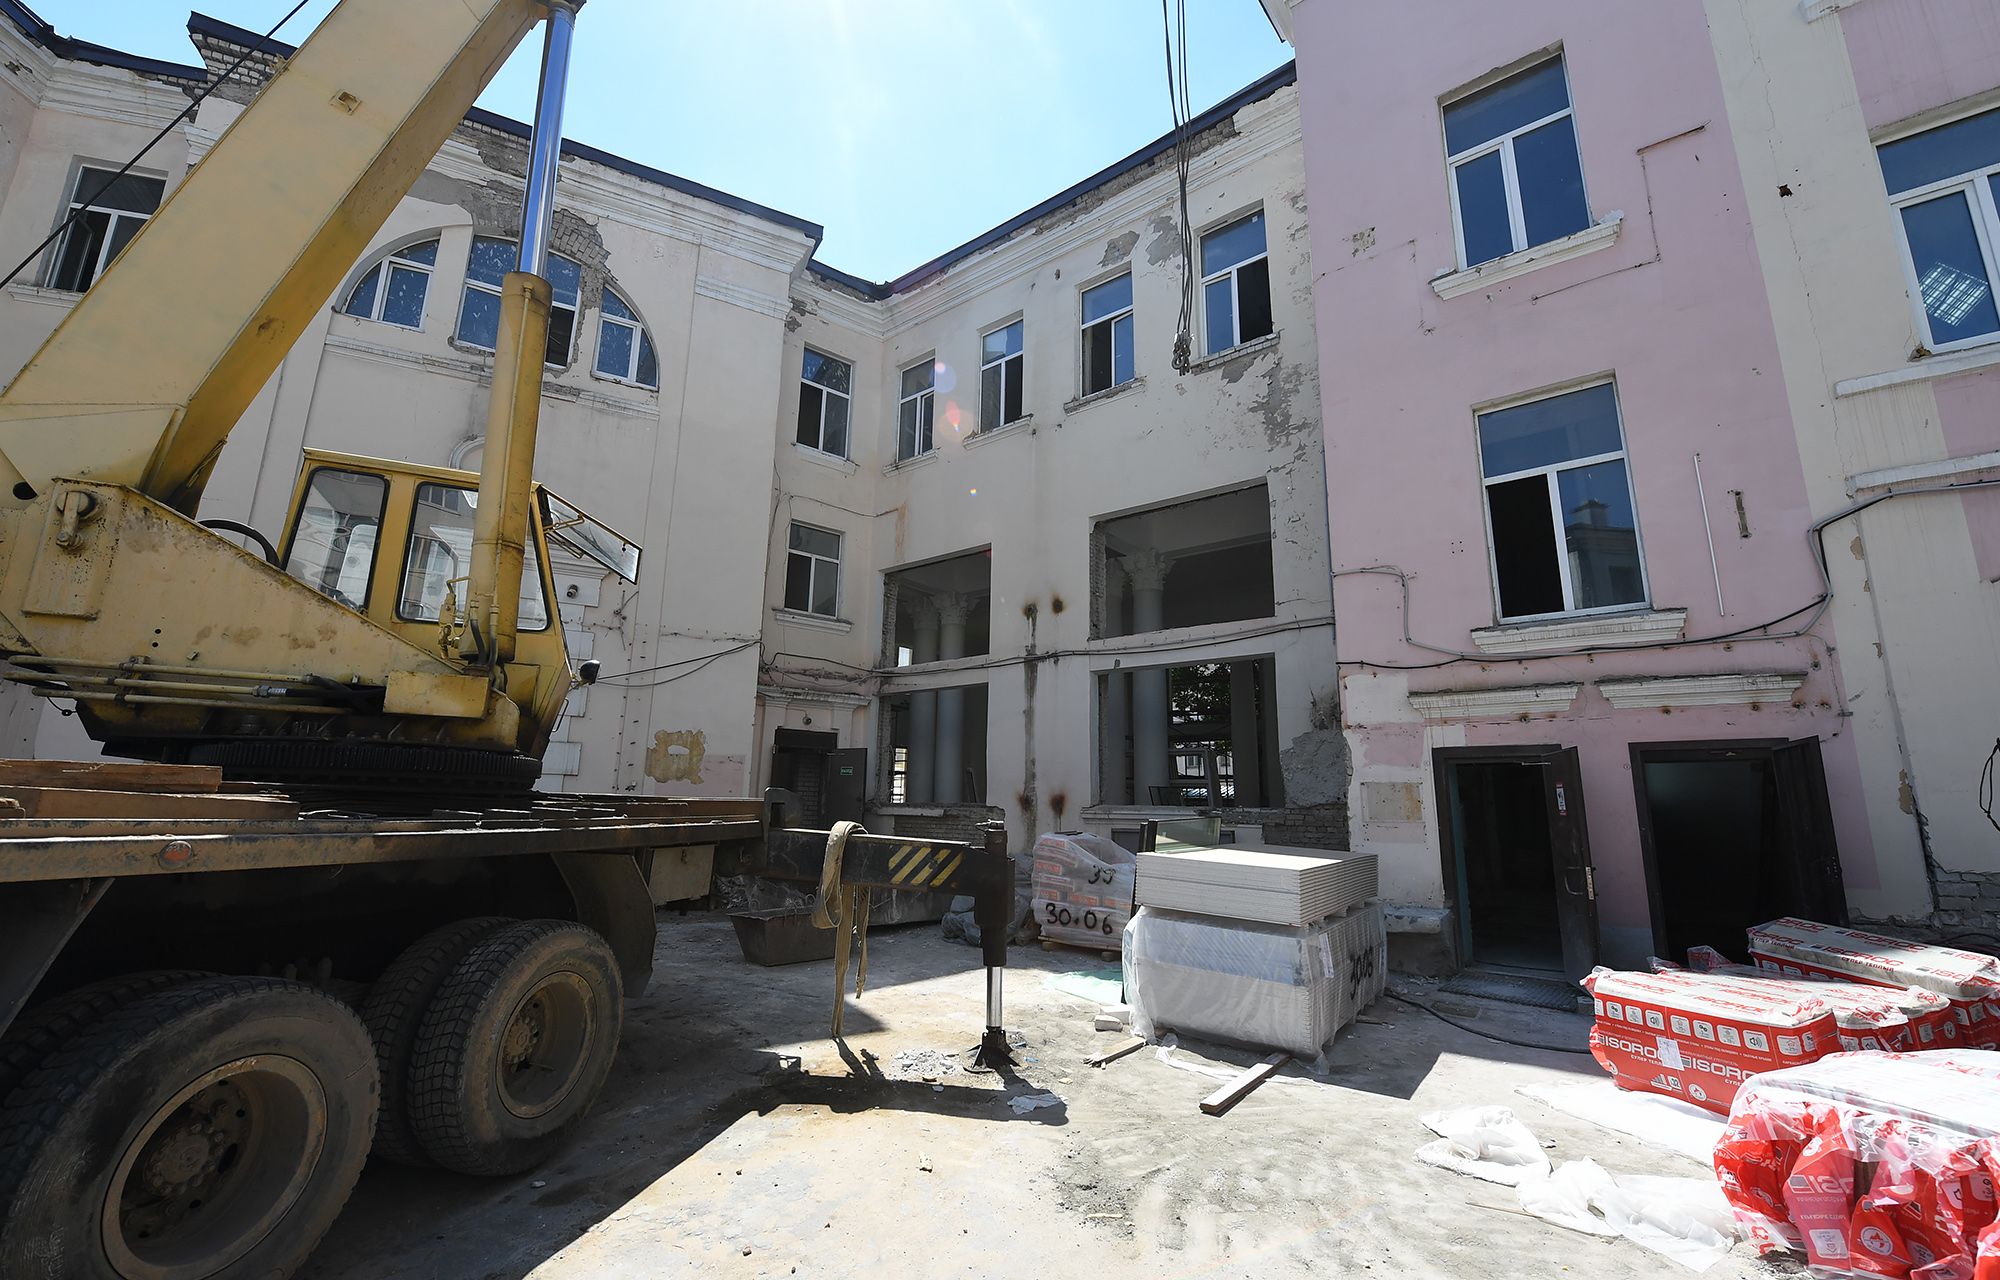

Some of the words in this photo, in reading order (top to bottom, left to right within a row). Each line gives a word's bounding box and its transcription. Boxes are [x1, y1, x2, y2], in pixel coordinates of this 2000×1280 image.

[1045, 902, 1113, 935] 30.06
[1845, 931, 1929, 951] ISOROC
[1823, 946, 1904, 966] ISOROC
